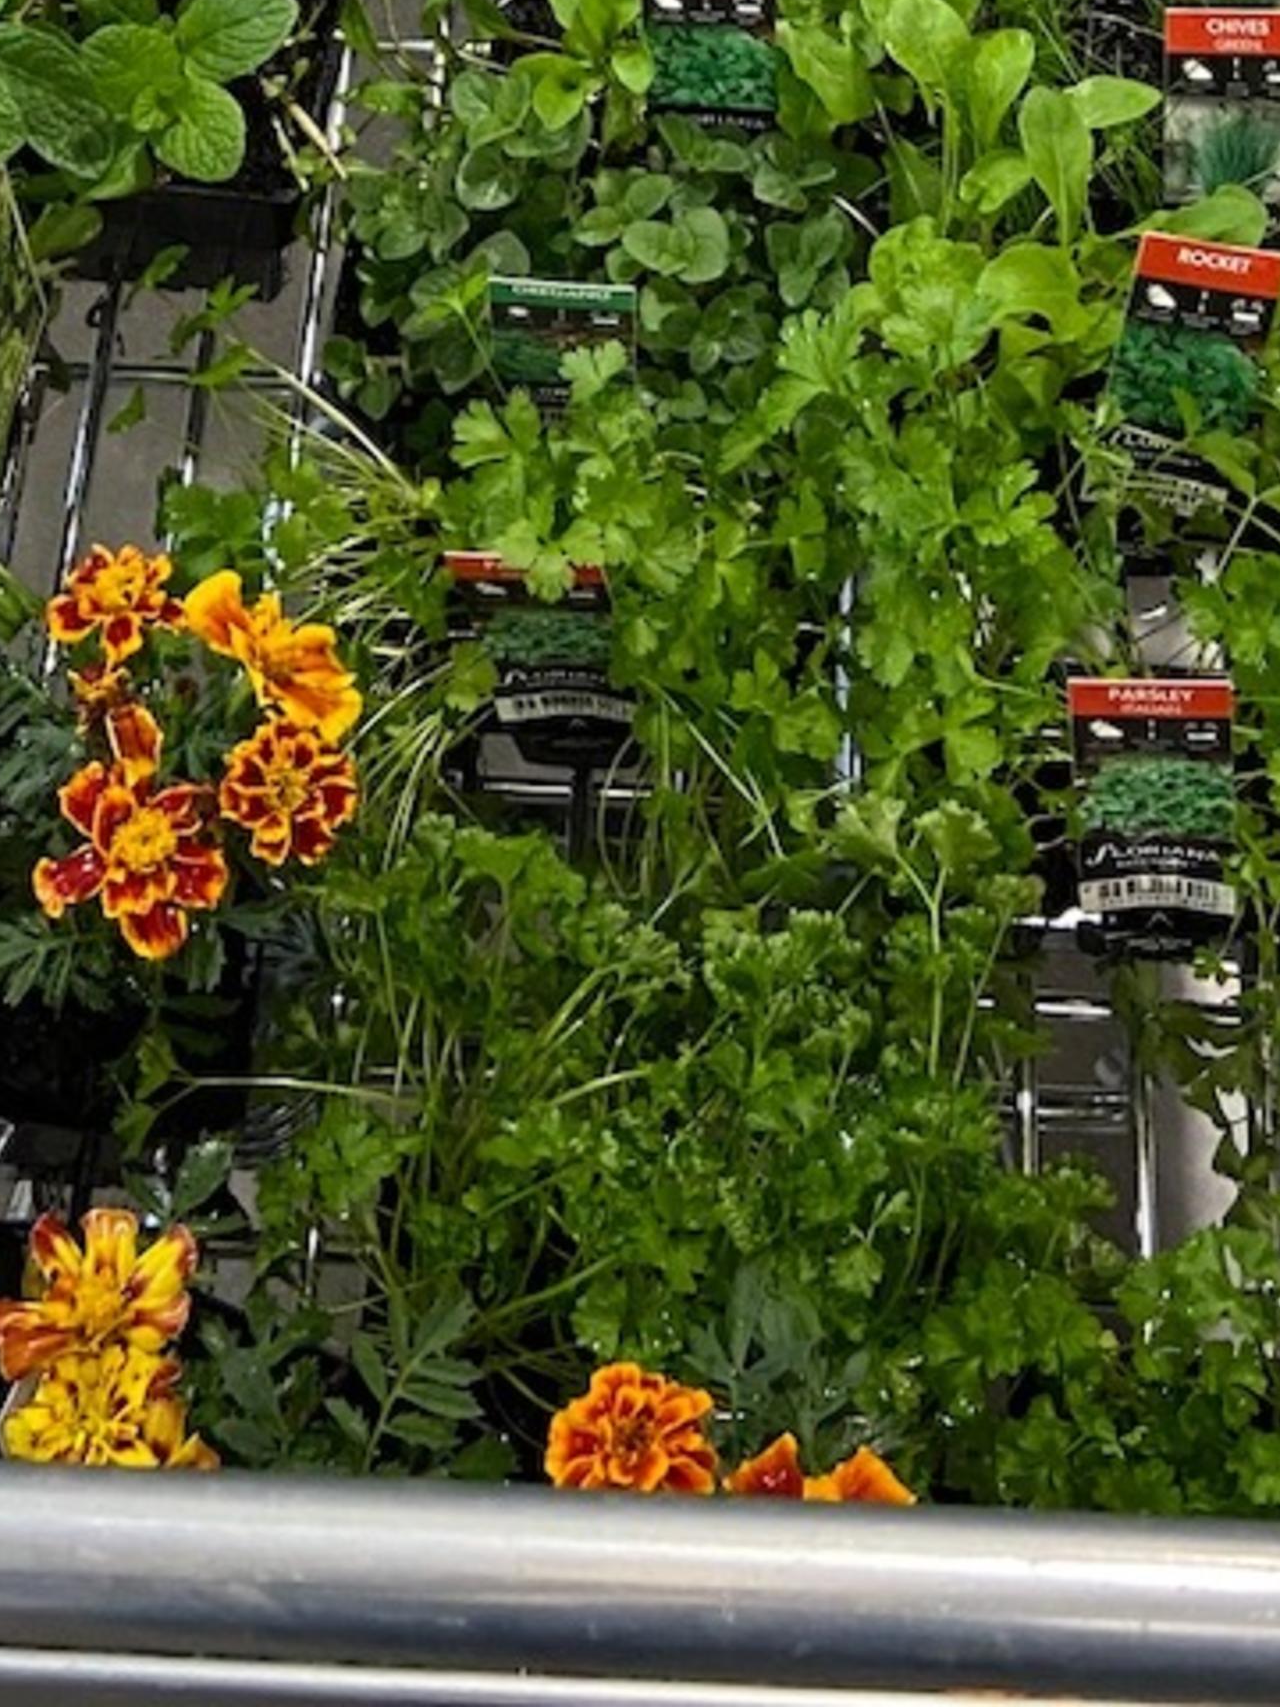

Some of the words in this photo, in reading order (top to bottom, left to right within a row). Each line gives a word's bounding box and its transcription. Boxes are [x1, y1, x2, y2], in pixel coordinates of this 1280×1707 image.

[1204, 17, 1270, 37] CHIVES
[1176, 246, 1253, 275] ROCKET
[1108, 688, 1196, 703] PARSLEY
